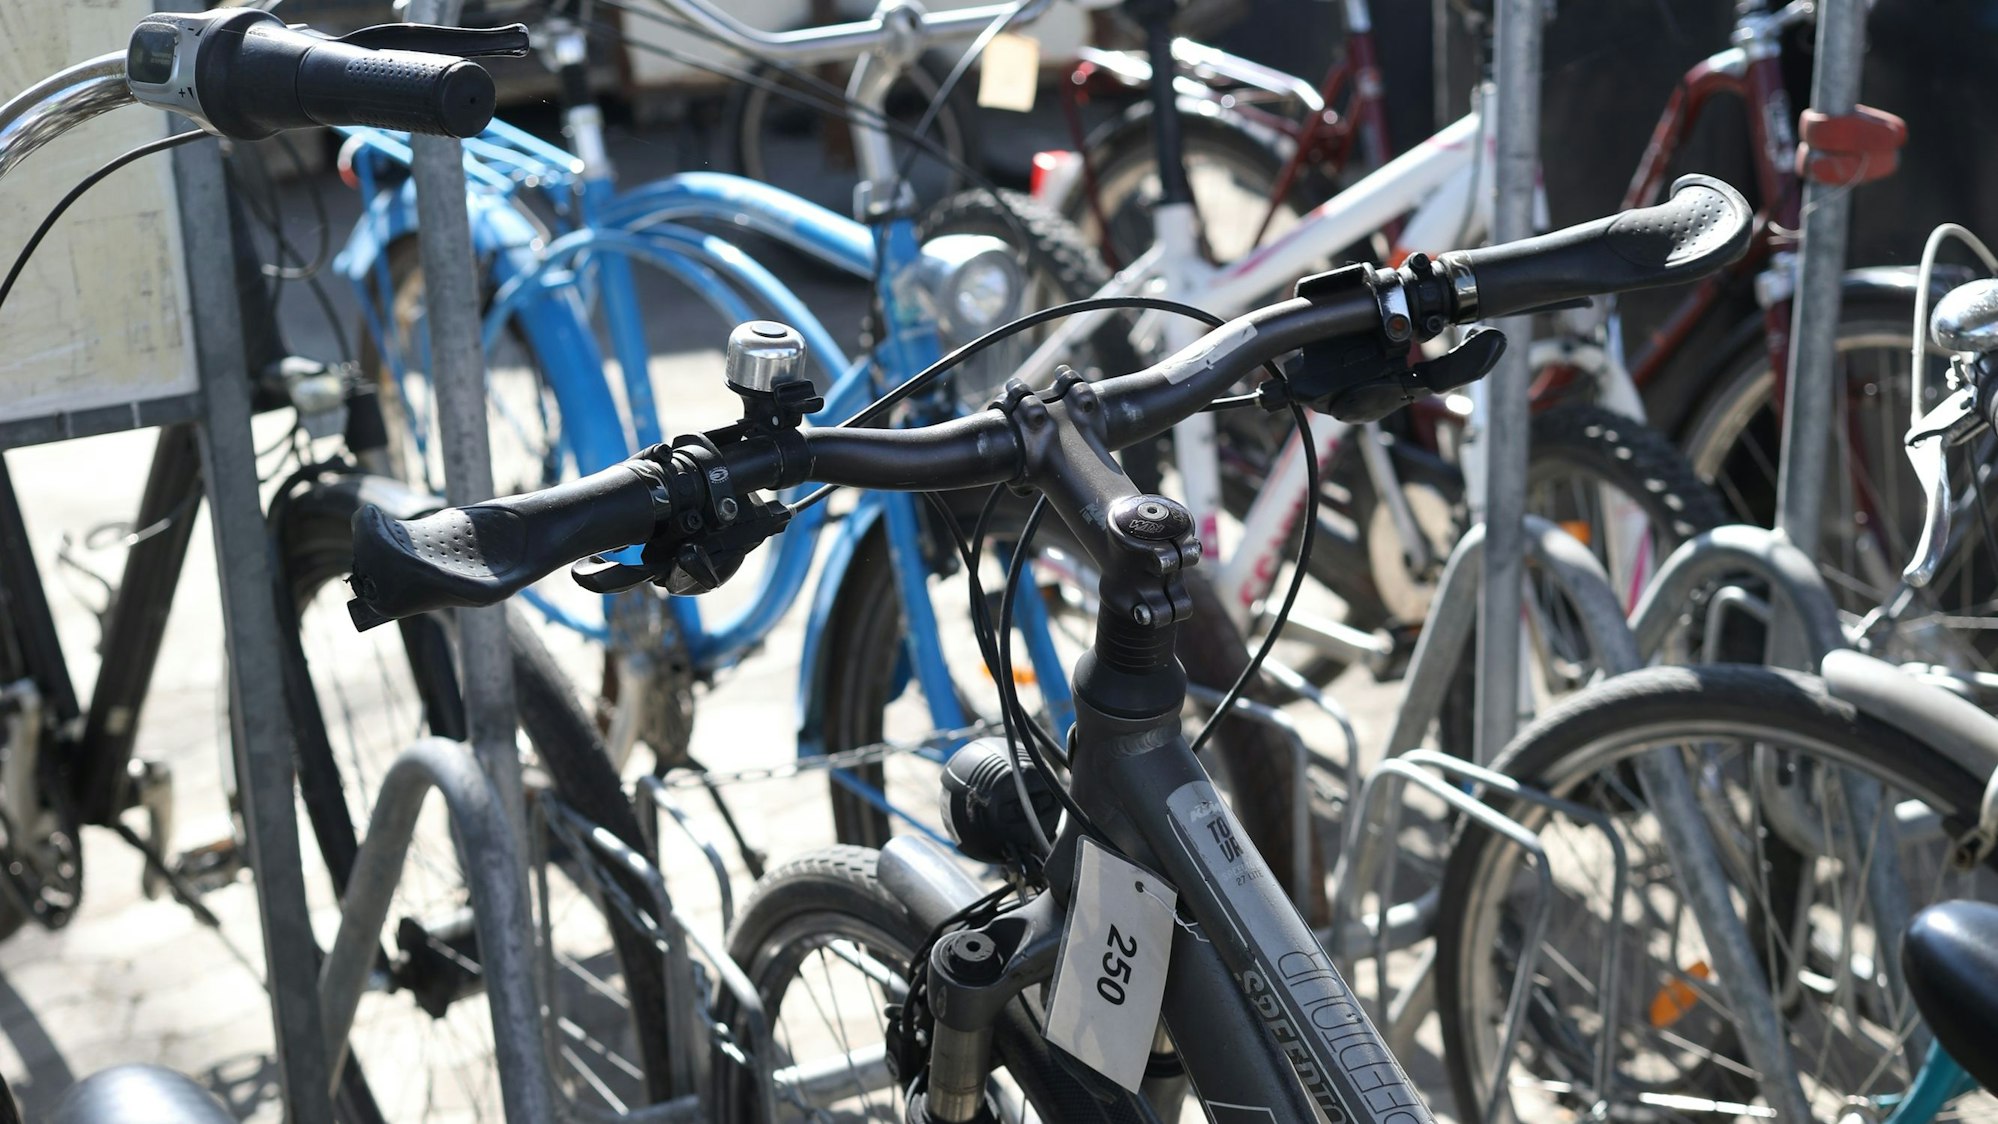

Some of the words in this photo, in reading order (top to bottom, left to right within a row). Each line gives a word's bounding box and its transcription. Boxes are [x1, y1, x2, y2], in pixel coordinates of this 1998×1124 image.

[1206, 816, 1231, 844] TO
[1236, 875, 1246, 886] 27
[1096, 923, 1137, 1006] 250
